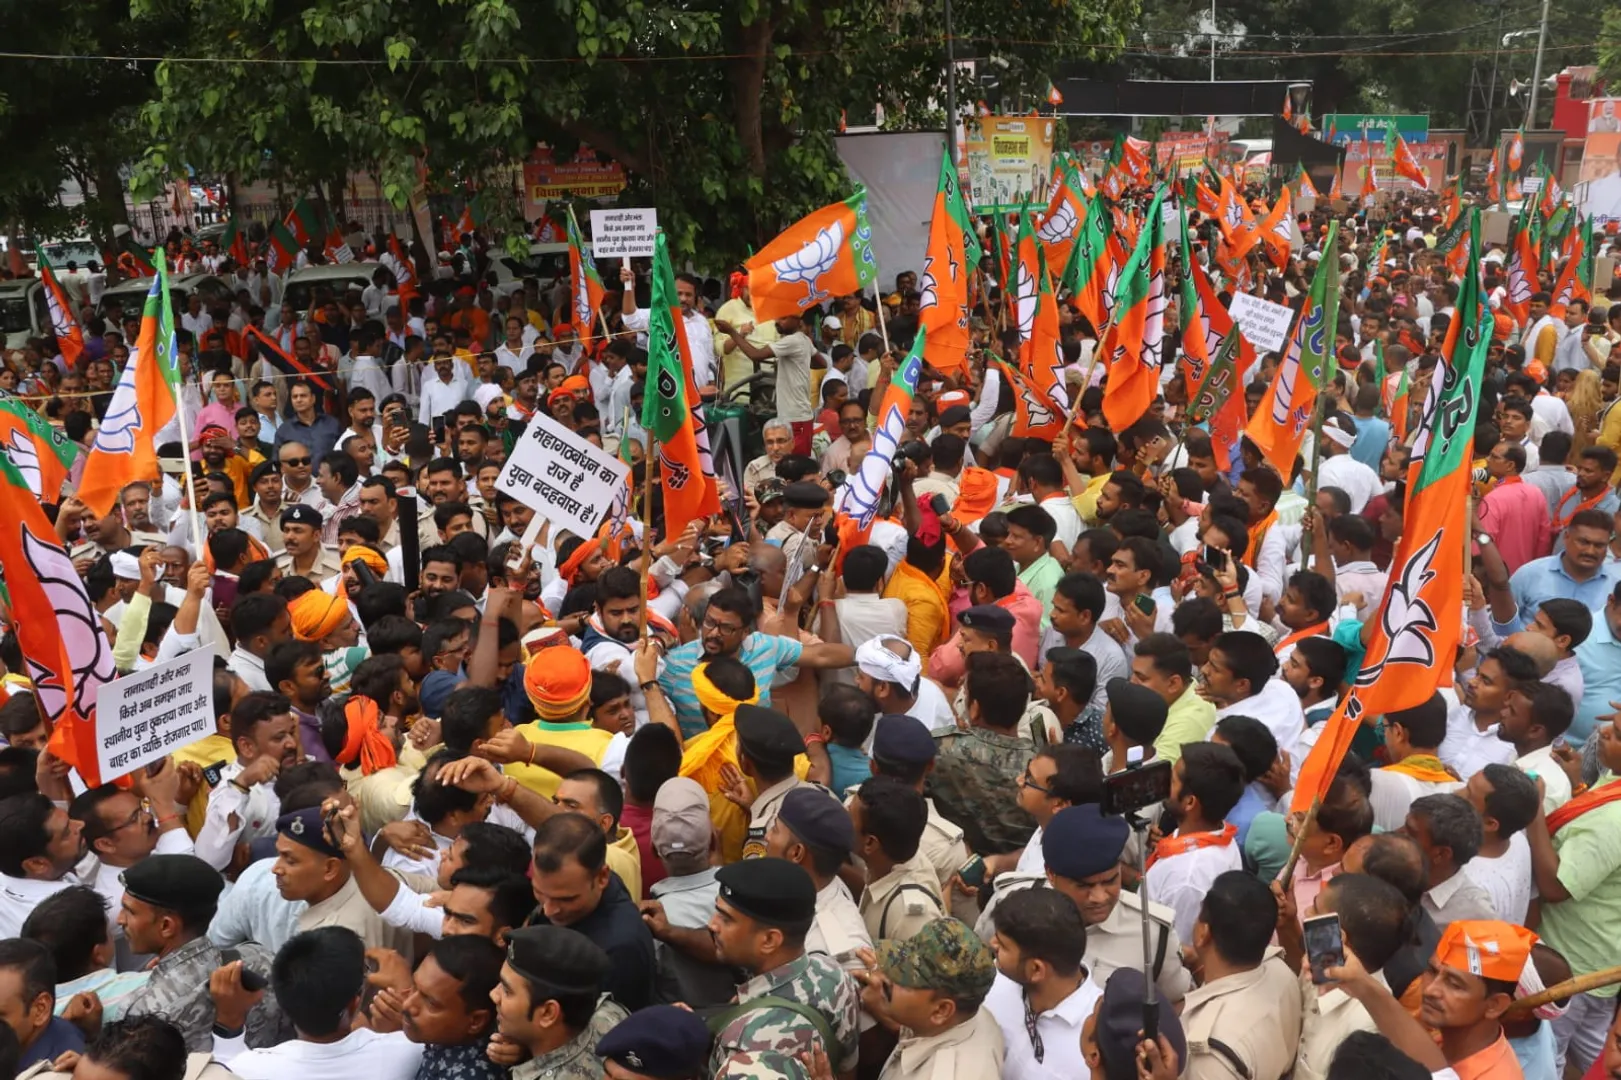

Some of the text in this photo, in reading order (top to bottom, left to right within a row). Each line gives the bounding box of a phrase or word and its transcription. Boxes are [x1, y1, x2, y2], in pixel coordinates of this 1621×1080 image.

[532, 426, 619, 486] महागठबंधन का
[546, 460, 584, 492] राज है
[506, 464, 534, 488] युवा
[532, 478, 582, 516] बदहवास
[119, 682, 193, 720] किसे अब समझा जाए
[124, 664, 191, 698] तानाशाही और भला
[104, 694, 207, 749] स्थानीय युवा ठुकराया जाए और
[109, 752, 128, 768] बाहर
[130, 746, 141, 759] का
[142, 735, 162, 754] व्यक्ति
[164, 725, 191, 746] रोजगार
